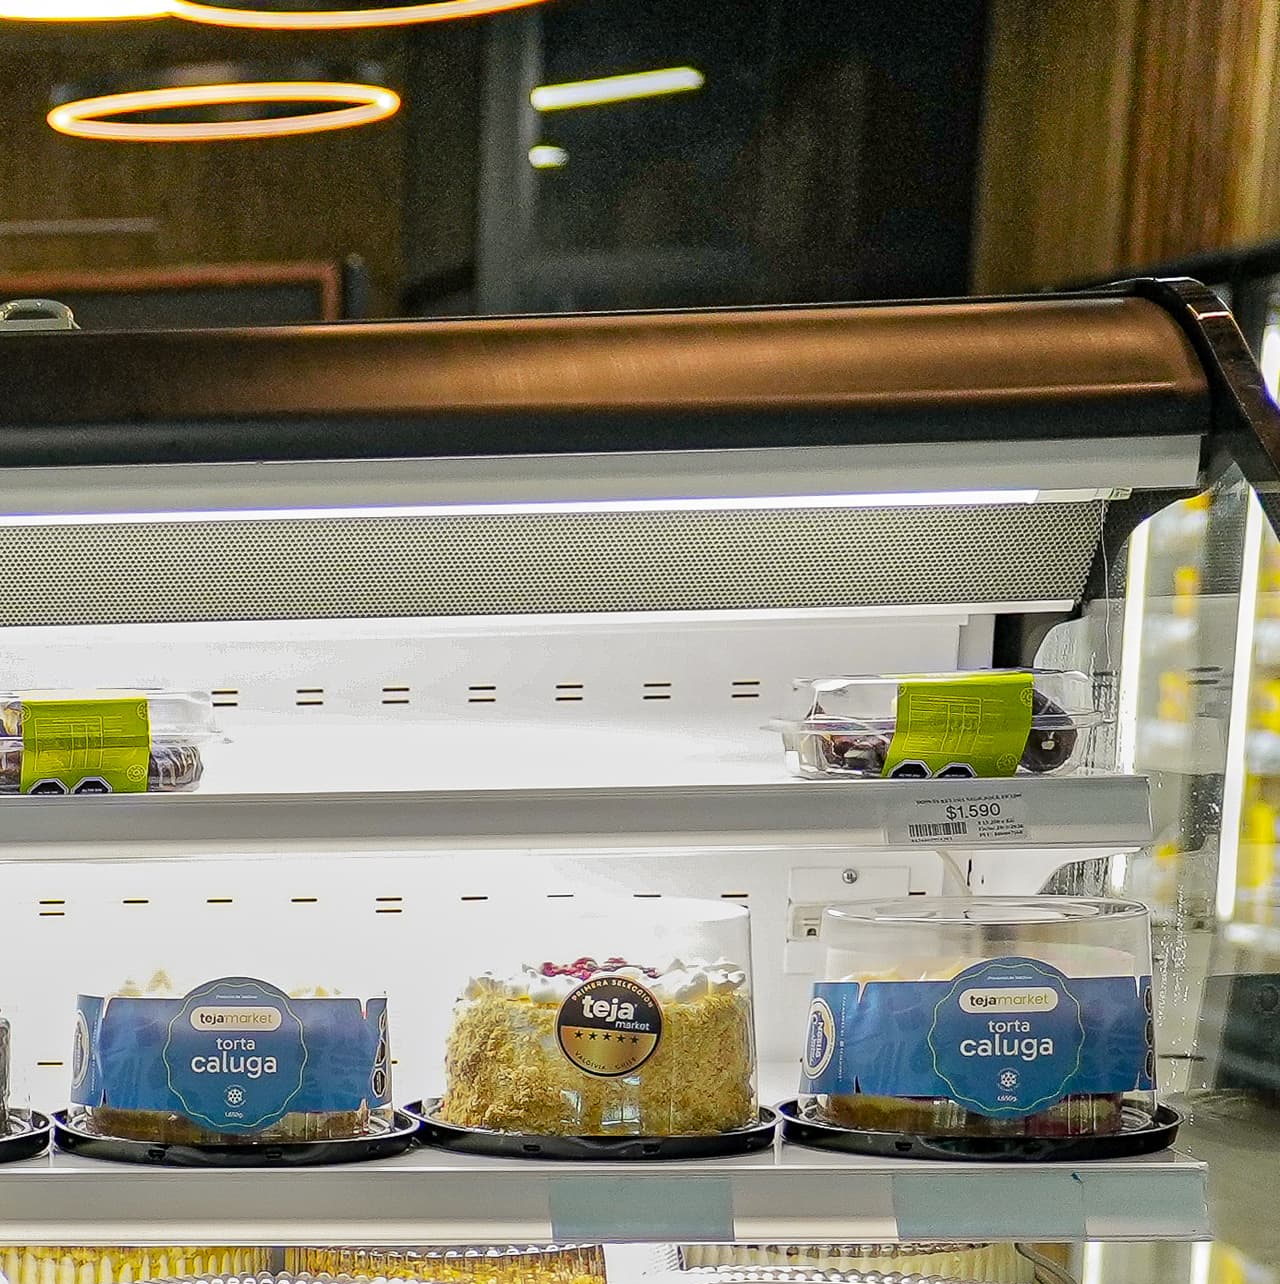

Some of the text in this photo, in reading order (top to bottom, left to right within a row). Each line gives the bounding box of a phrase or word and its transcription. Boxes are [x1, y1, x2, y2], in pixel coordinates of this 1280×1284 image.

[946, 803, 1001, 820] $1.590
[970, 993, 1049, 1007] tejamarket
[582, 995, 635, 1022] teja
[200, 1013, 272, 1025] tejamarket
[615, 1020, 650, 1031] market
[988, 1018, 1031, 1034] torta
[216, 1037, 255, 1050] torta
[960, 1034, 1054, 1061] caluga
[191, 1051, 277, 1079] caluga
